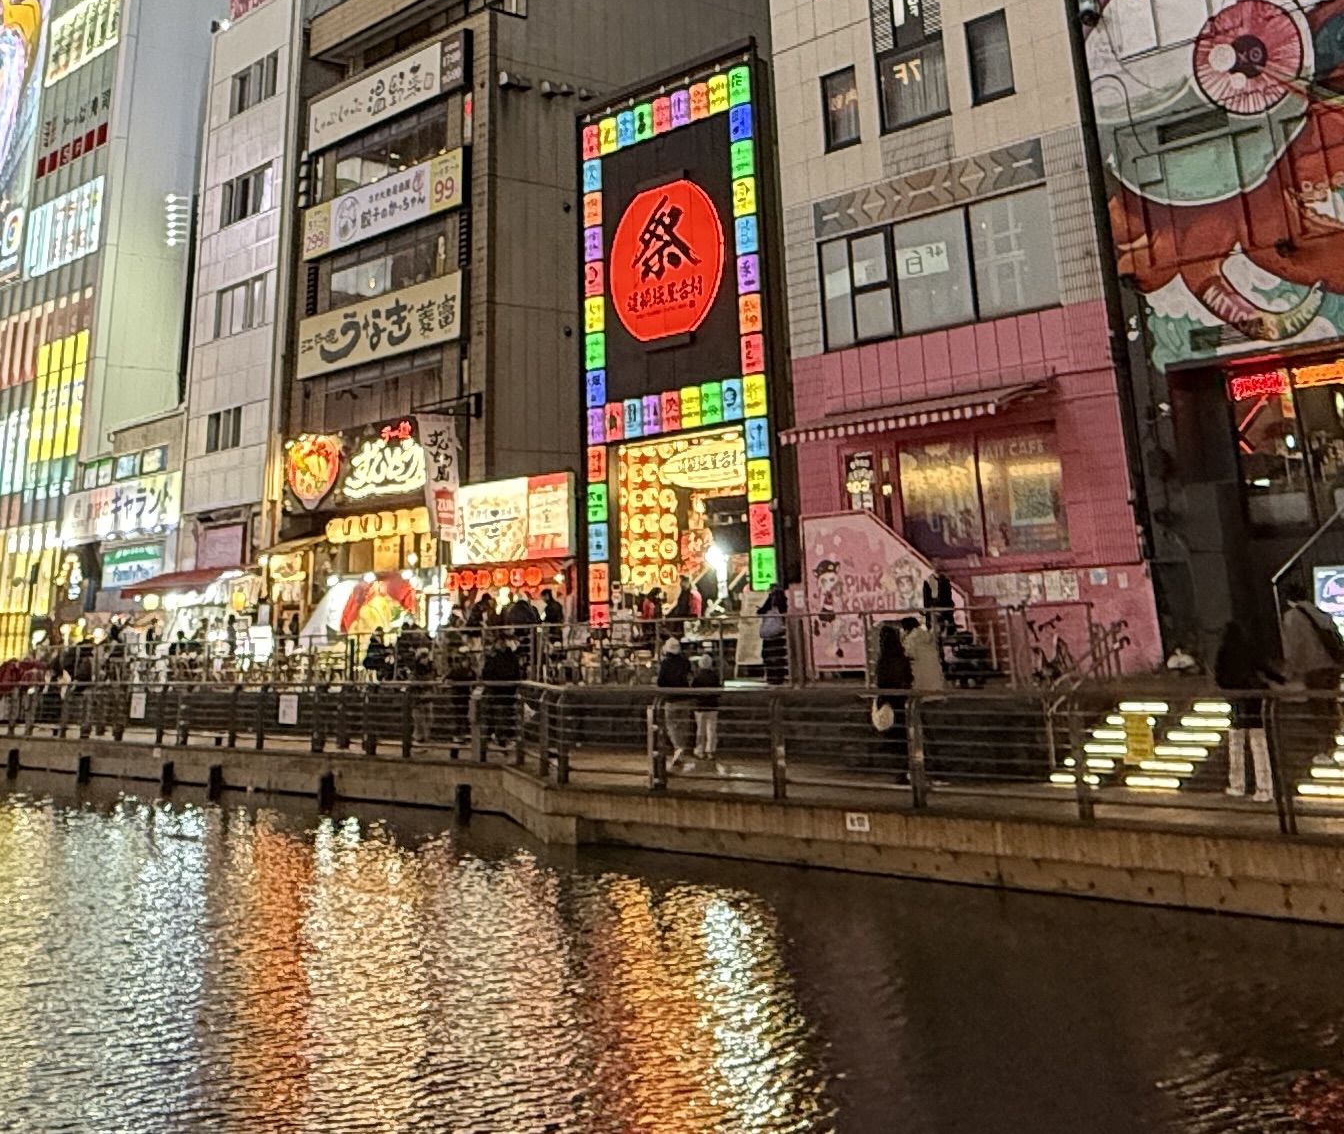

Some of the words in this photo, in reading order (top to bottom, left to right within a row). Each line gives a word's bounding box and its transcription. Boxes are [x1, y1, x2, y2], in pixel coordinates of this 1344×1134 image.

[632, 194, 703, 284] 祭
[319, 298, 414, 364] うなぎ
[842, 592, 897, 613] KAWAII
[844, 573, 884, 593] PINK
